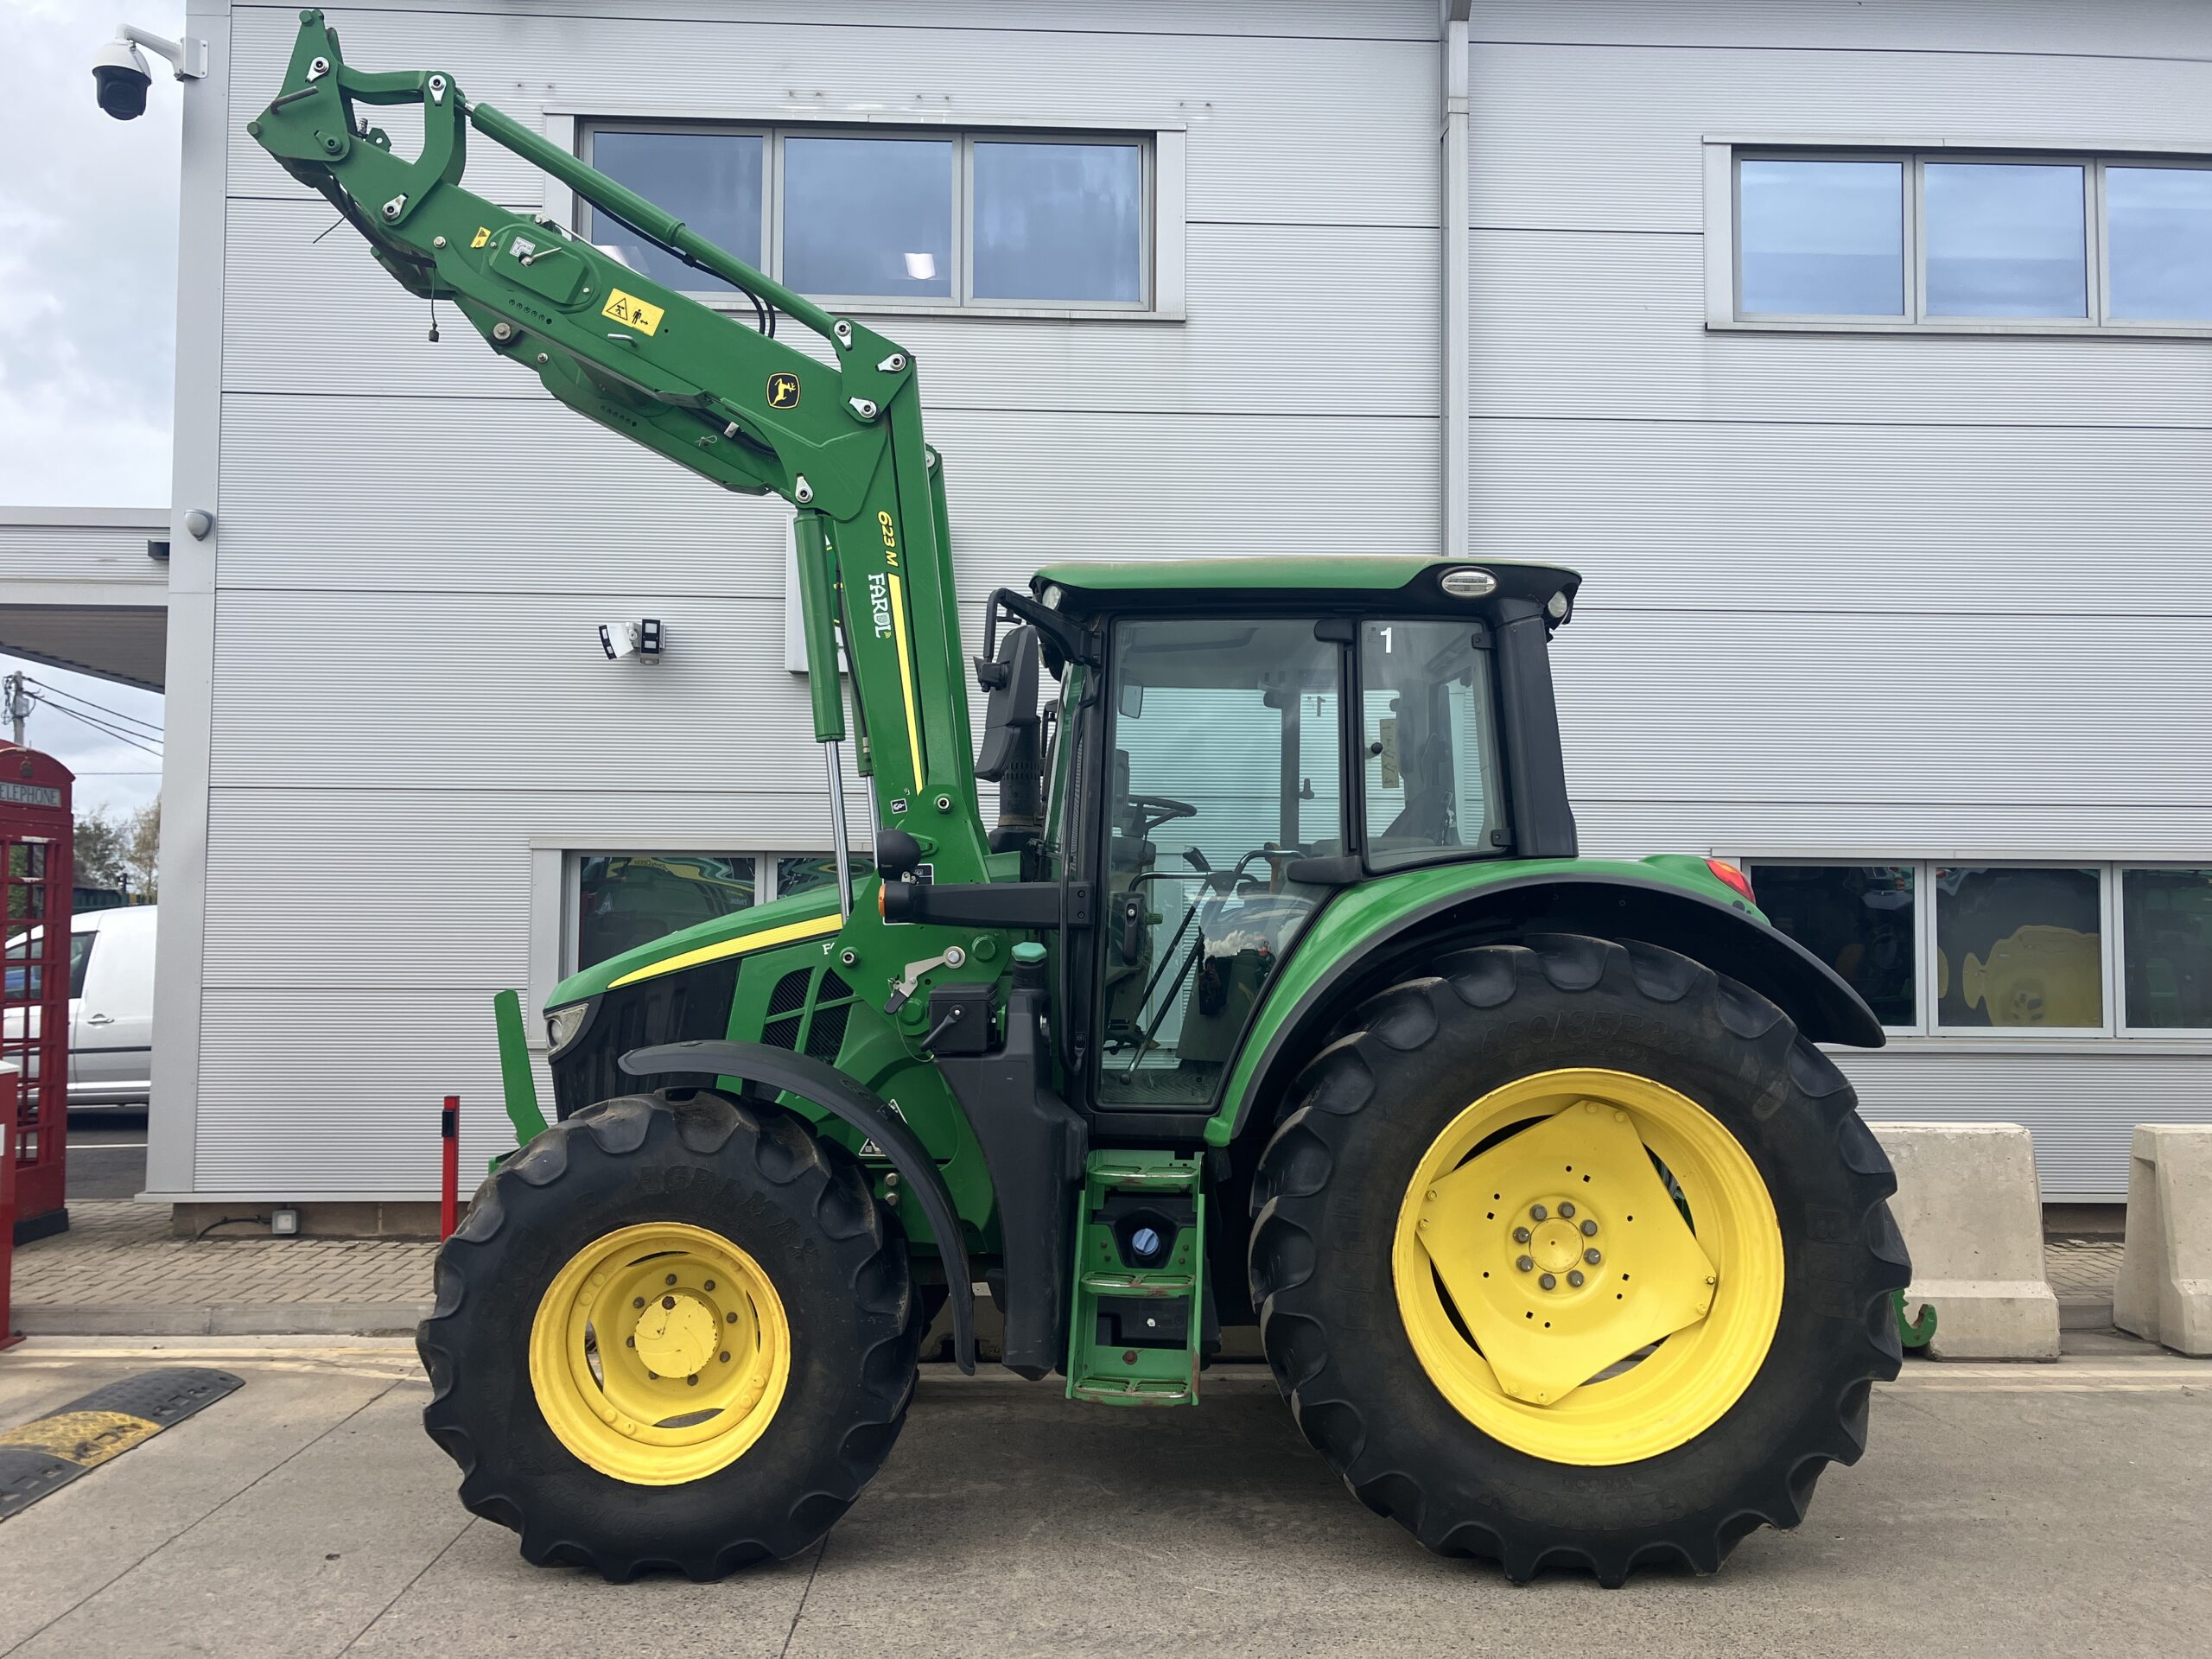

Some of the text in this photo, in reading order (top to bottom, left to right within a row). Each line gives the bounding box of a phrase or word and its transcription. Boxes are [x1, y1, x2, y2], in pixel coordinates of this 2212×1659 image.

[877, 510, 899, 568] 623 M
[868, 573, 890, 639] FAROL
[1380, 626, 1392, 654] 1
[0, 783, 58, 805] ELEPHONE
